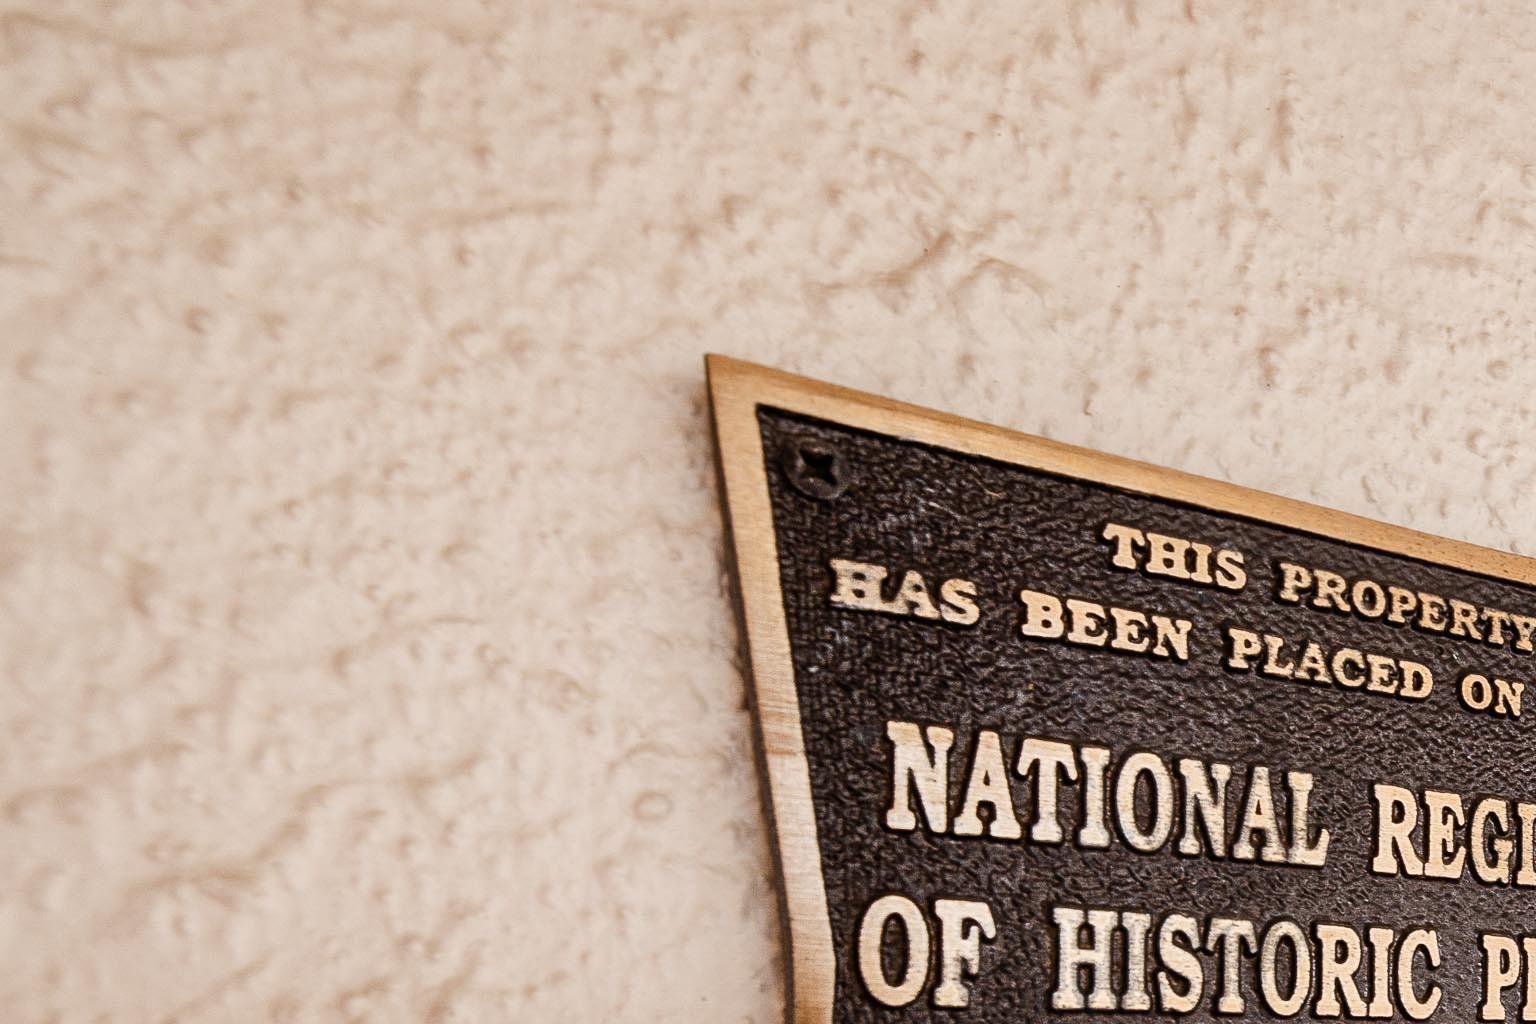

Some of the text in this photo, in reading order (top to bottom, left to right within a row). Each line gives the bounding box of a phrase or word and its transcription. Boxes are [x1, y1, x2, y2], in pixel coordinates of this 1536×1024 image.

[1103, 524, 1246, 589] THIS
[831, 560, 979, 624] HAS
[1021, 590, 1192, 659] BEEN
[1229, 628, 1433, 697] PLACED
[1462, 674, 1524, 716] ON
[887, 721, 1330, 865] NATIONAL
[859, 895, 996, 1006] OF
[1053, 908, 1443, 1019] HISTORIC
